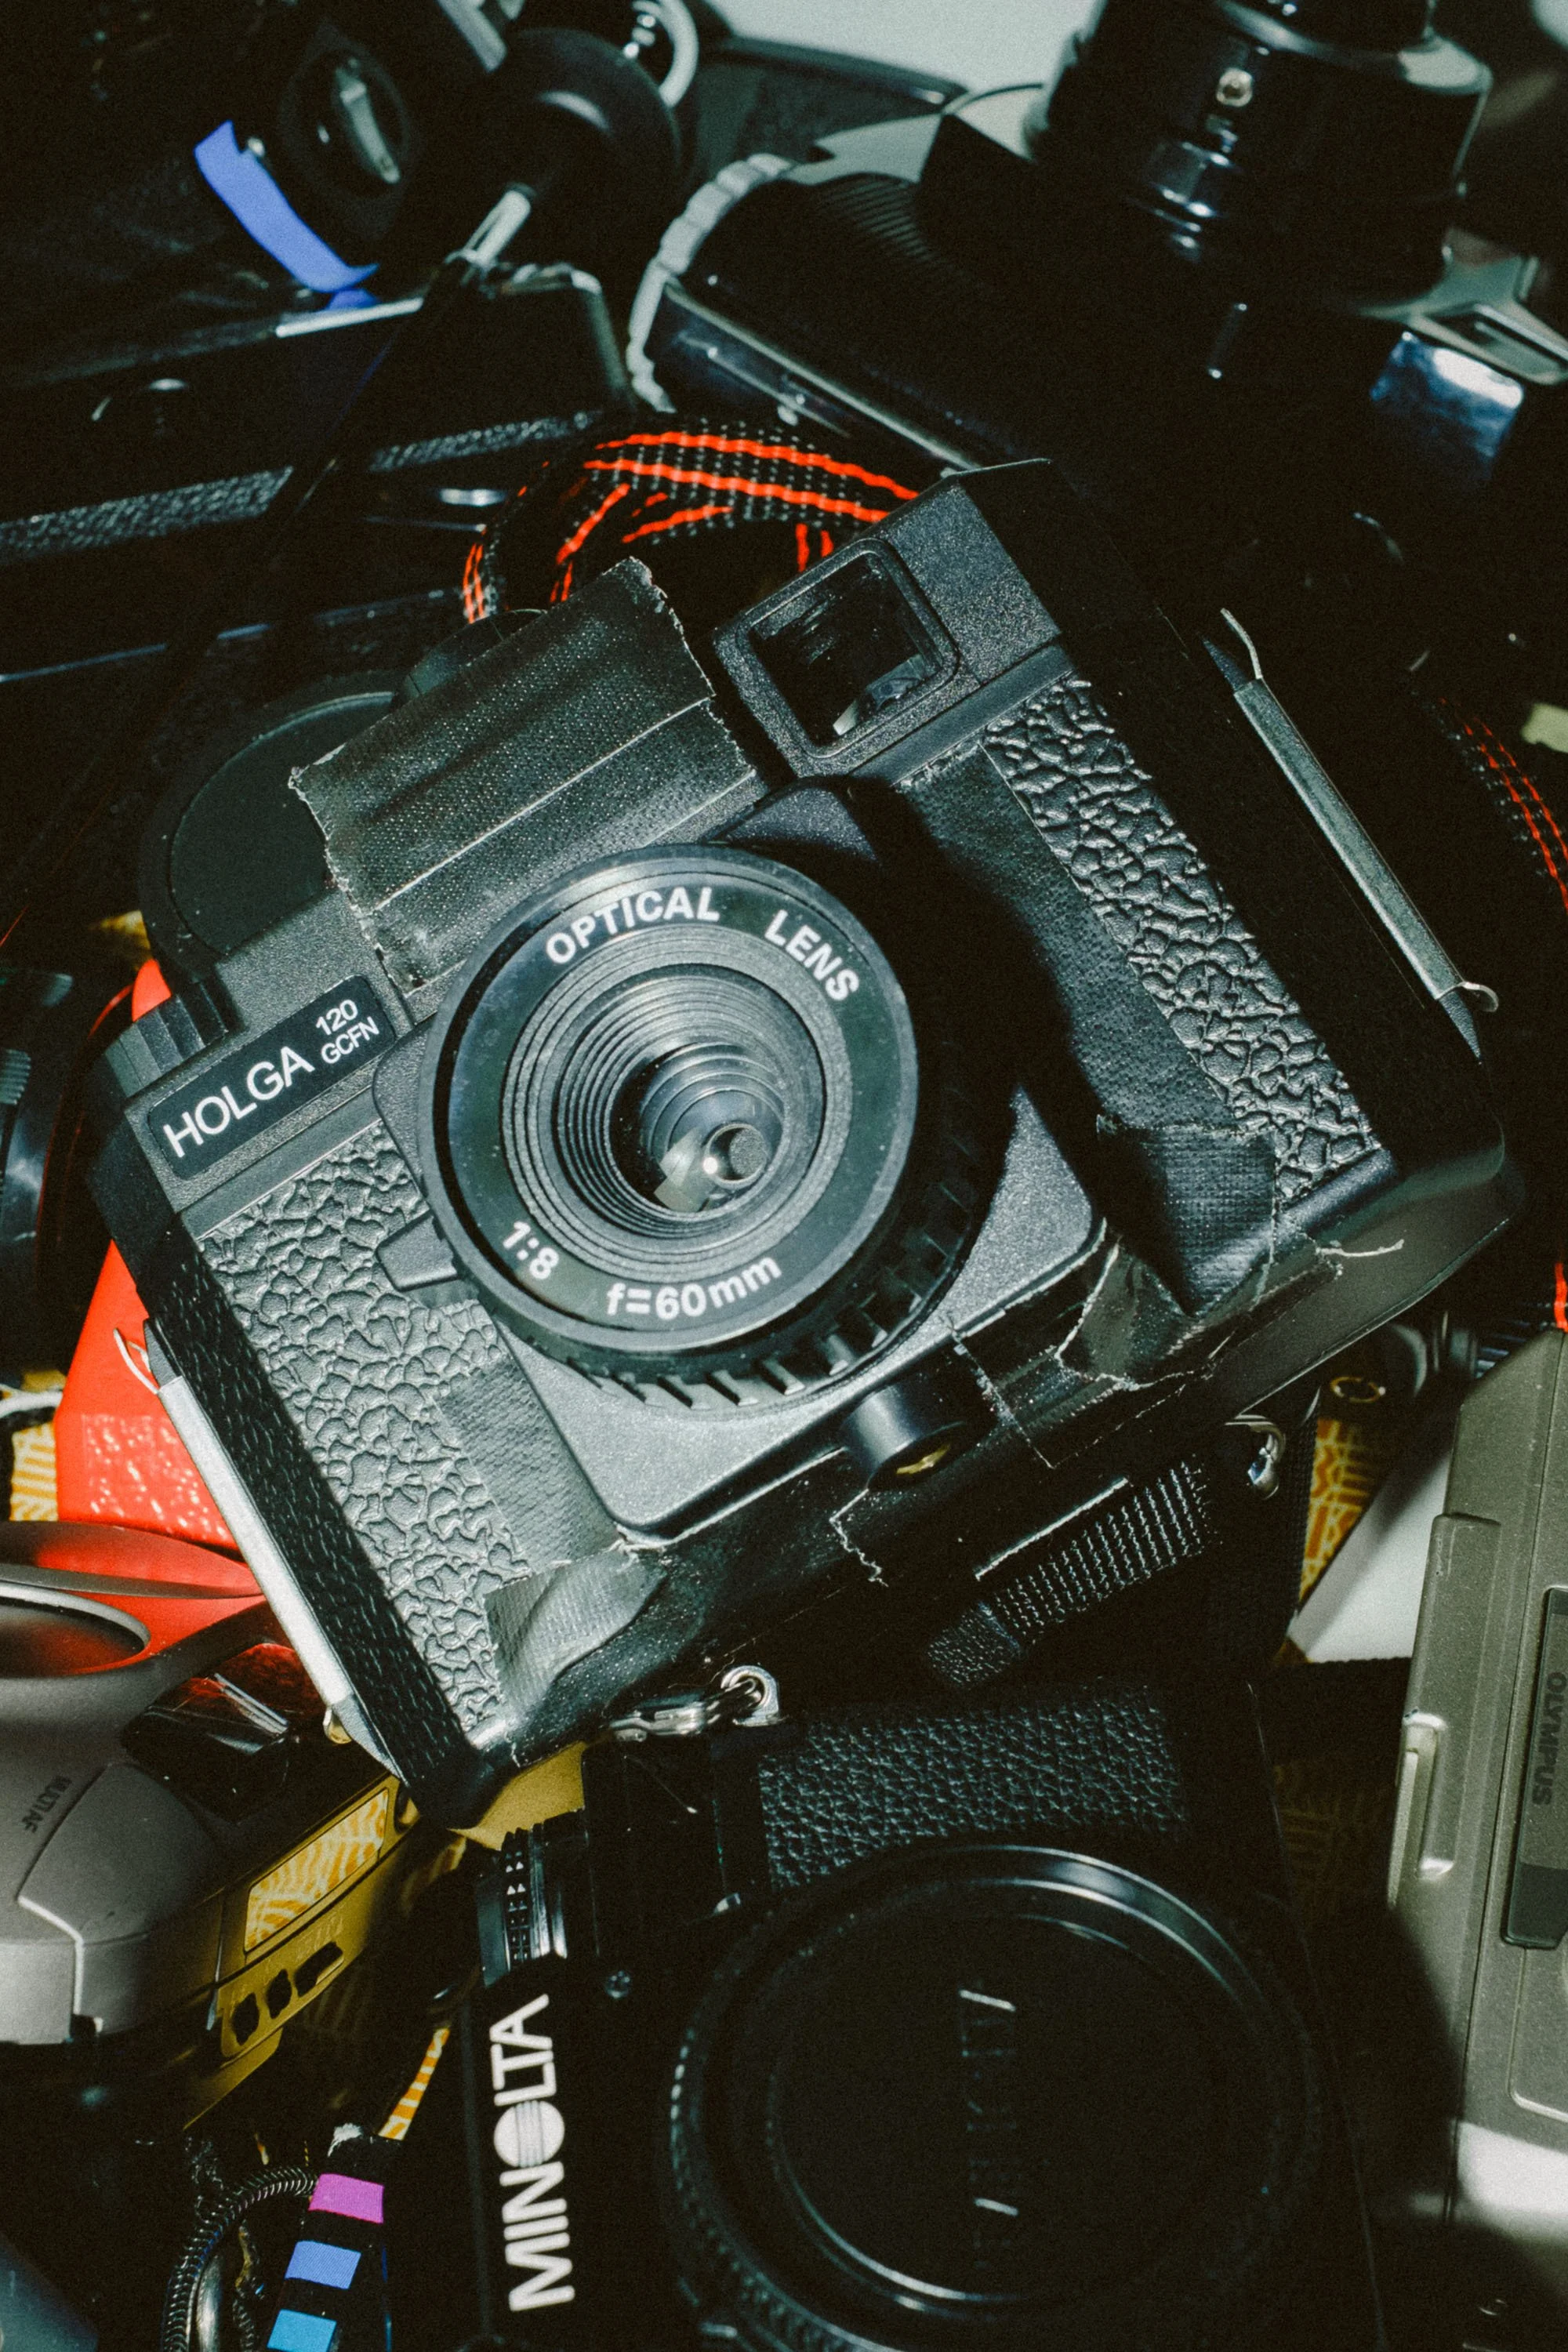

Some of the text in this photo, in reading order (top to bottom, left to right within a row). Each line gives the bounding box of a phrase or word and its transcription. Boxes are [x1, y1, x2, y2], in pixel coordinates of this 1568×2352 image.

[545, 886, 860, 1002] OPTICAL LENS
[315, 998, 358, 1036] 120
[320, 1016, 380, 1065] GCFN
[162, 1045, 315, 1159] HOLGA
[502, 1221, 560, 1280] 1:8
[606, 1256, 782, 1320] f=60mm
[1532, 1671, 1567, 1805] OLYMPUS
[489, 1993, 575, 2312] MINOLTA
